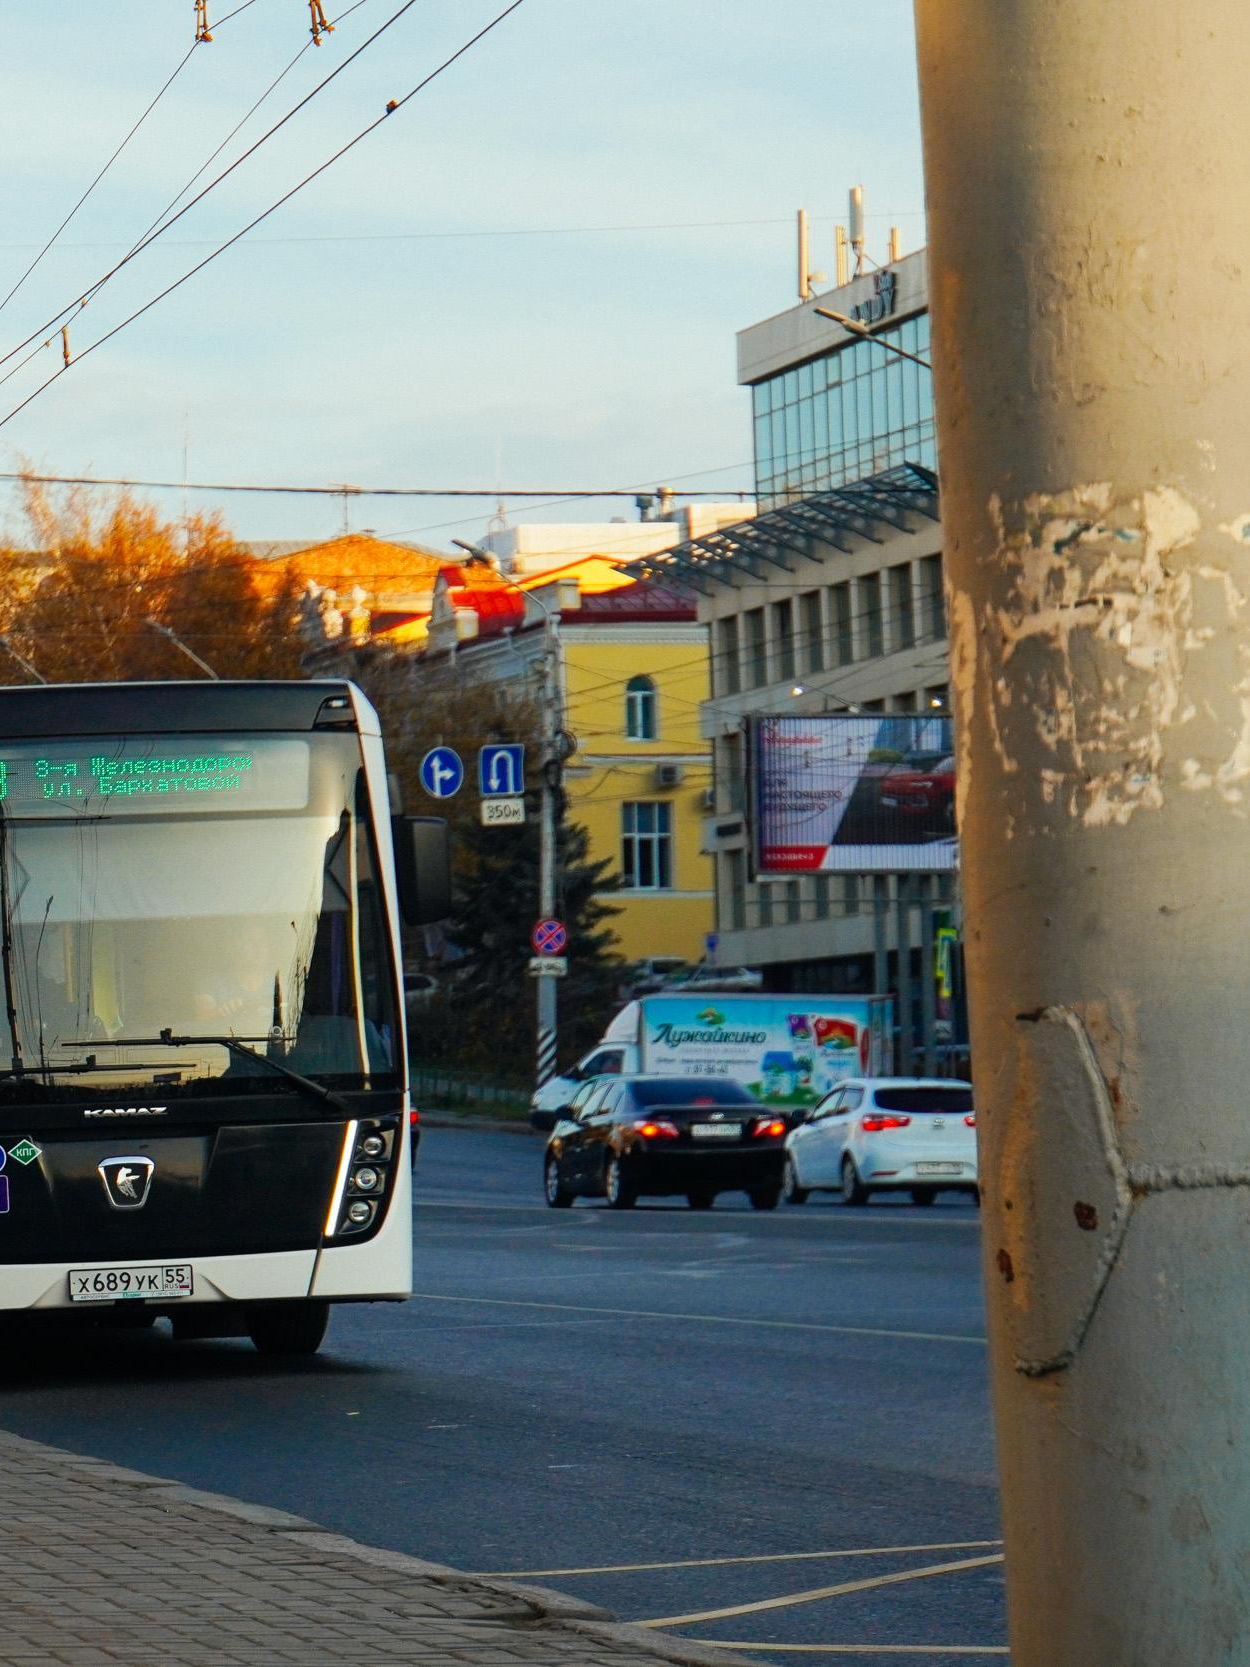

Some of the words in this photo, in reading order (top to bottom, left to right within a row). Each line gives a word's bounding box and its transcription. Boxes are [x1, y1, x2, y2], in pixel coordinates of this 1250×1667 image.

[35, 759, 78, 778] 3-я
[43, 781, 83, 799] ул.
[99, 773, 240, 795] Бархатовой
[765, 790, 842, 801] АСТОЯЩЕГО
[652, 1022, 767, 1048] Лужайкино
[84, 1106, 168, 1118] KAMAZ
[16, 1146, 35, 1157] КПГ
[165, 1268, 185, 1284] 55
